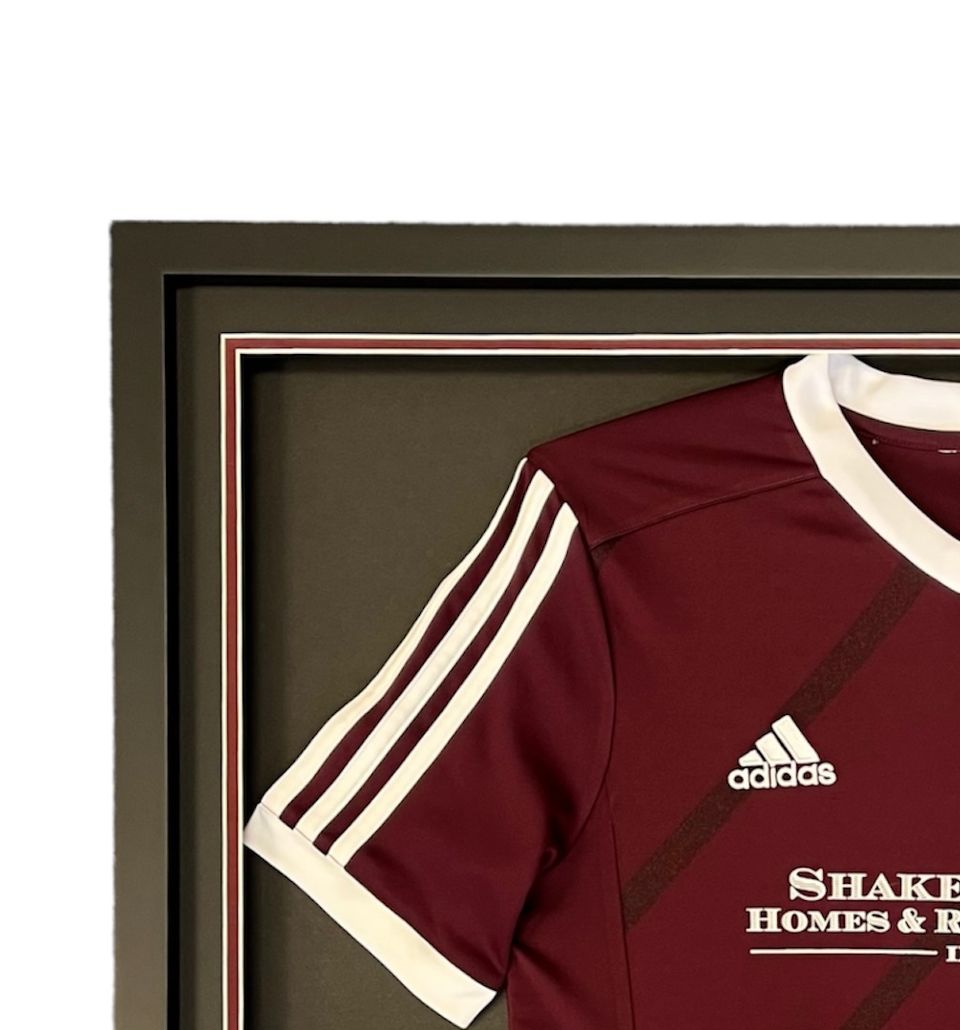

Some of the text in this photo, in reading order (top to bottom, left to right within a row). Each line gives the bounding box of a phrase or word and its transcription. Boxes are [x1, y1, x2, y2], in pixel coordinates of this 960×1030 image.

[728, 761, 837, 789] adidas
[745, 906, 890, 934] HOMES
[897, 906, 927, 935] &
